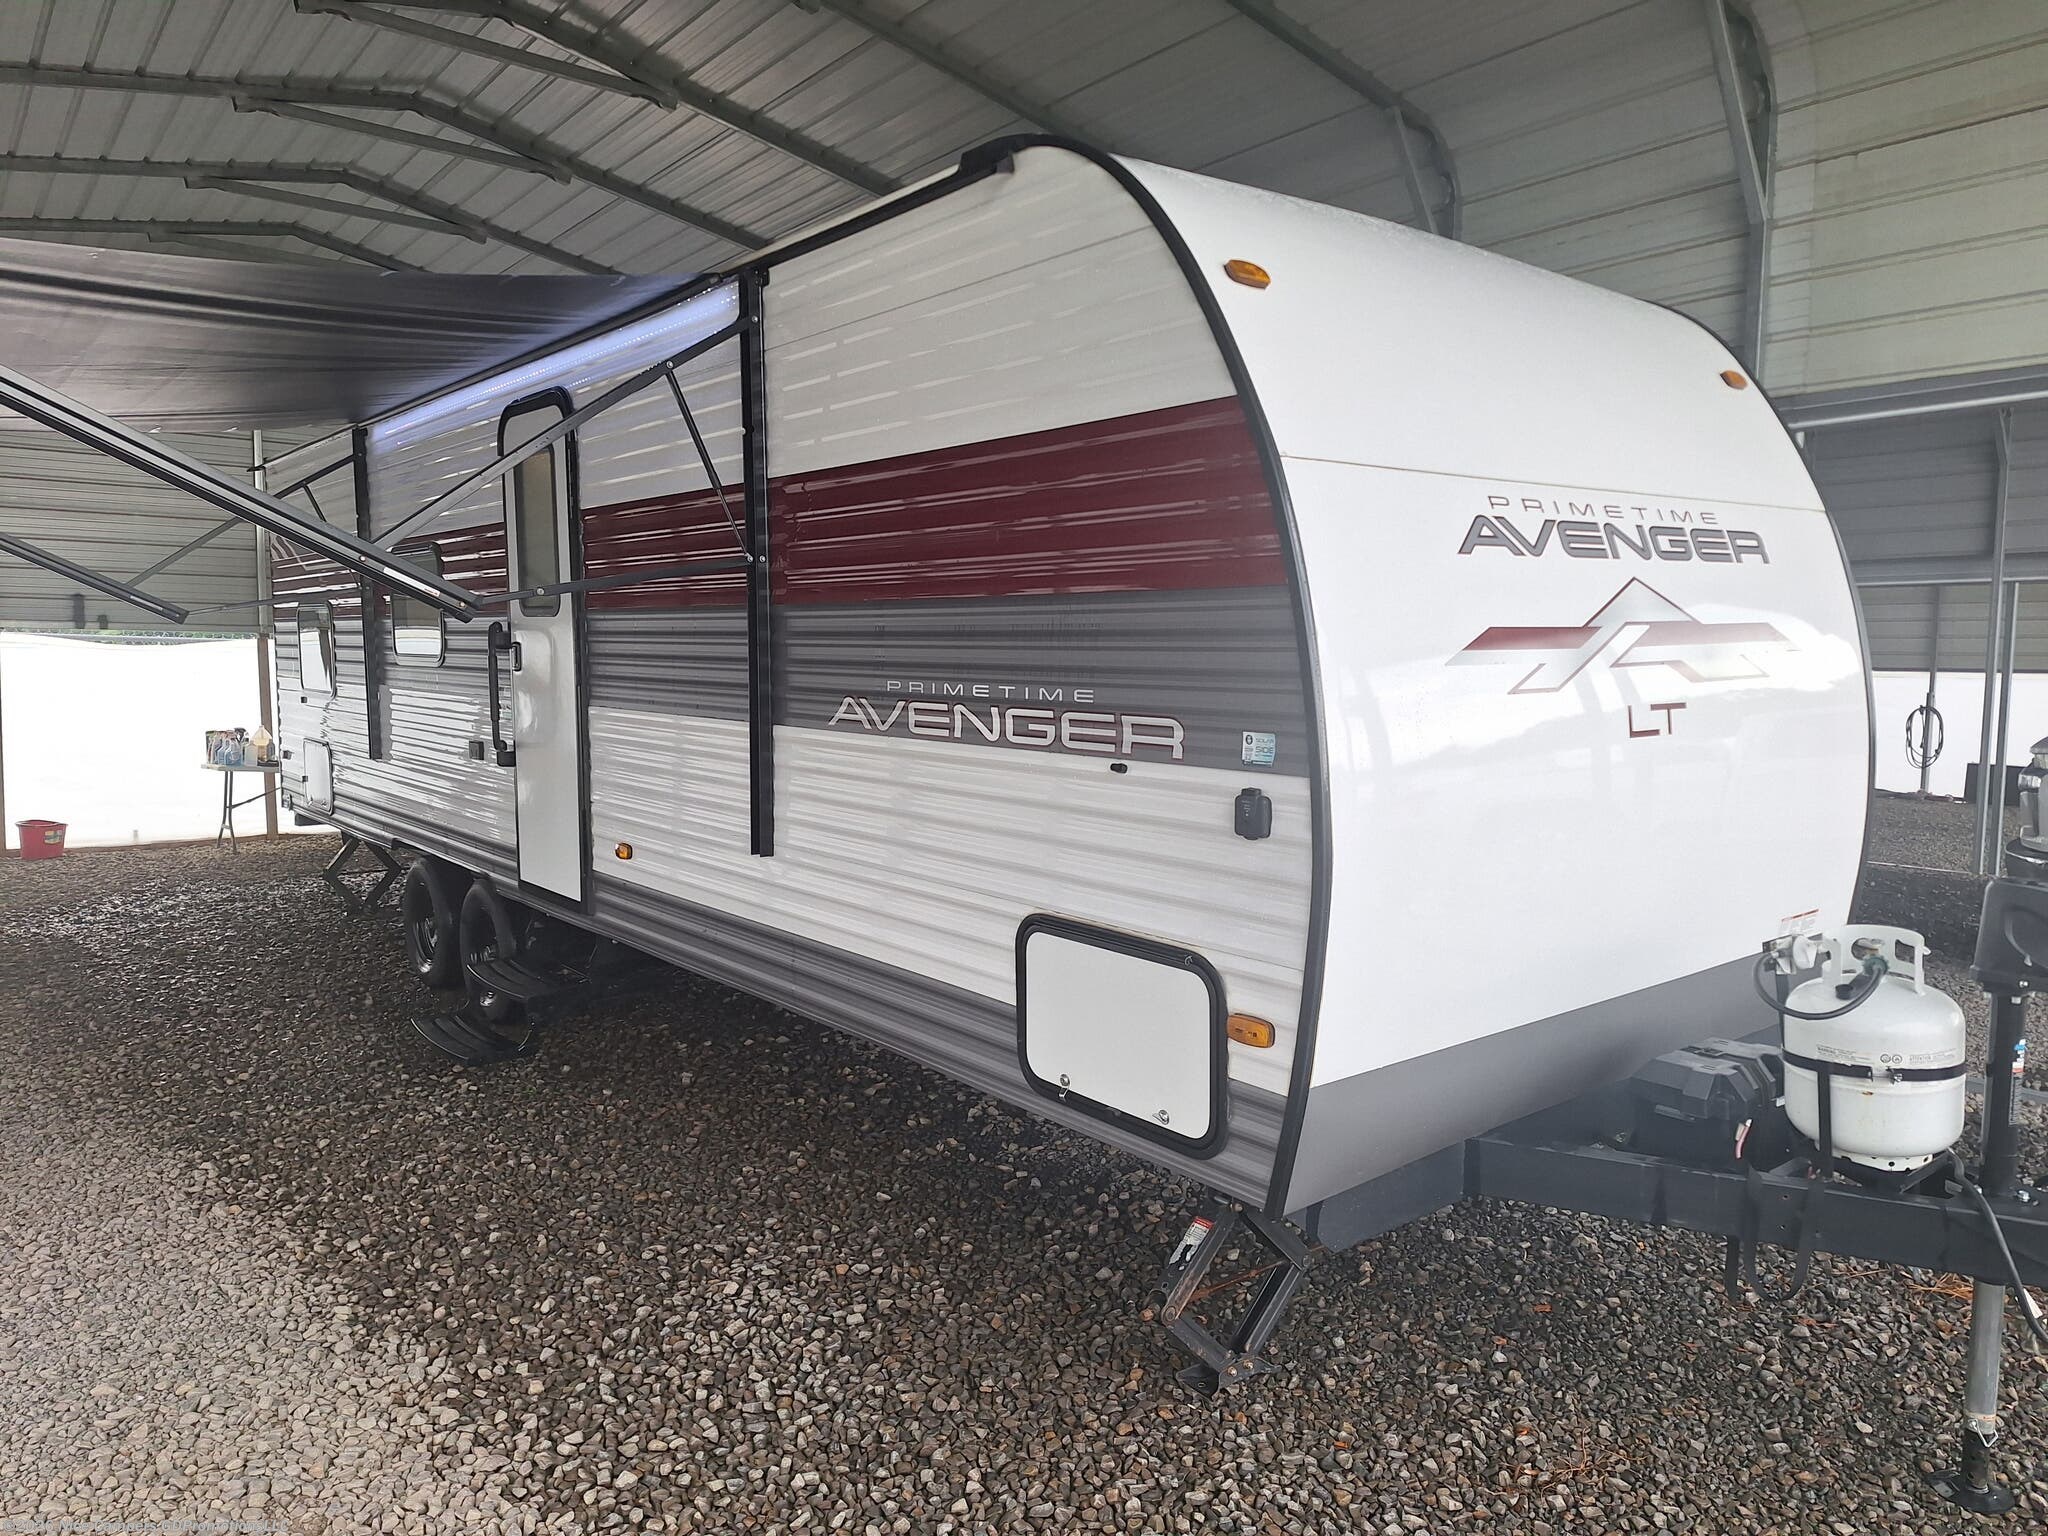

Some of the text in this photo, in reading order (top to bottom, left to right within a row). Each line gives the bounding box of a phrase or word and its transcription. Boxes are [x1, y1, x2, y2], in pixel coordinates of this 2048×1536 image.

[1487, 495, 1719, 525] PRIMETIME
[1457, 514, 1770, 564] AVENGER
[886, 680, 1095, 703] PRIMETIME
[827, 695, 1185, 760] AVENGER
[1627, 702, 1687, 738] LT
